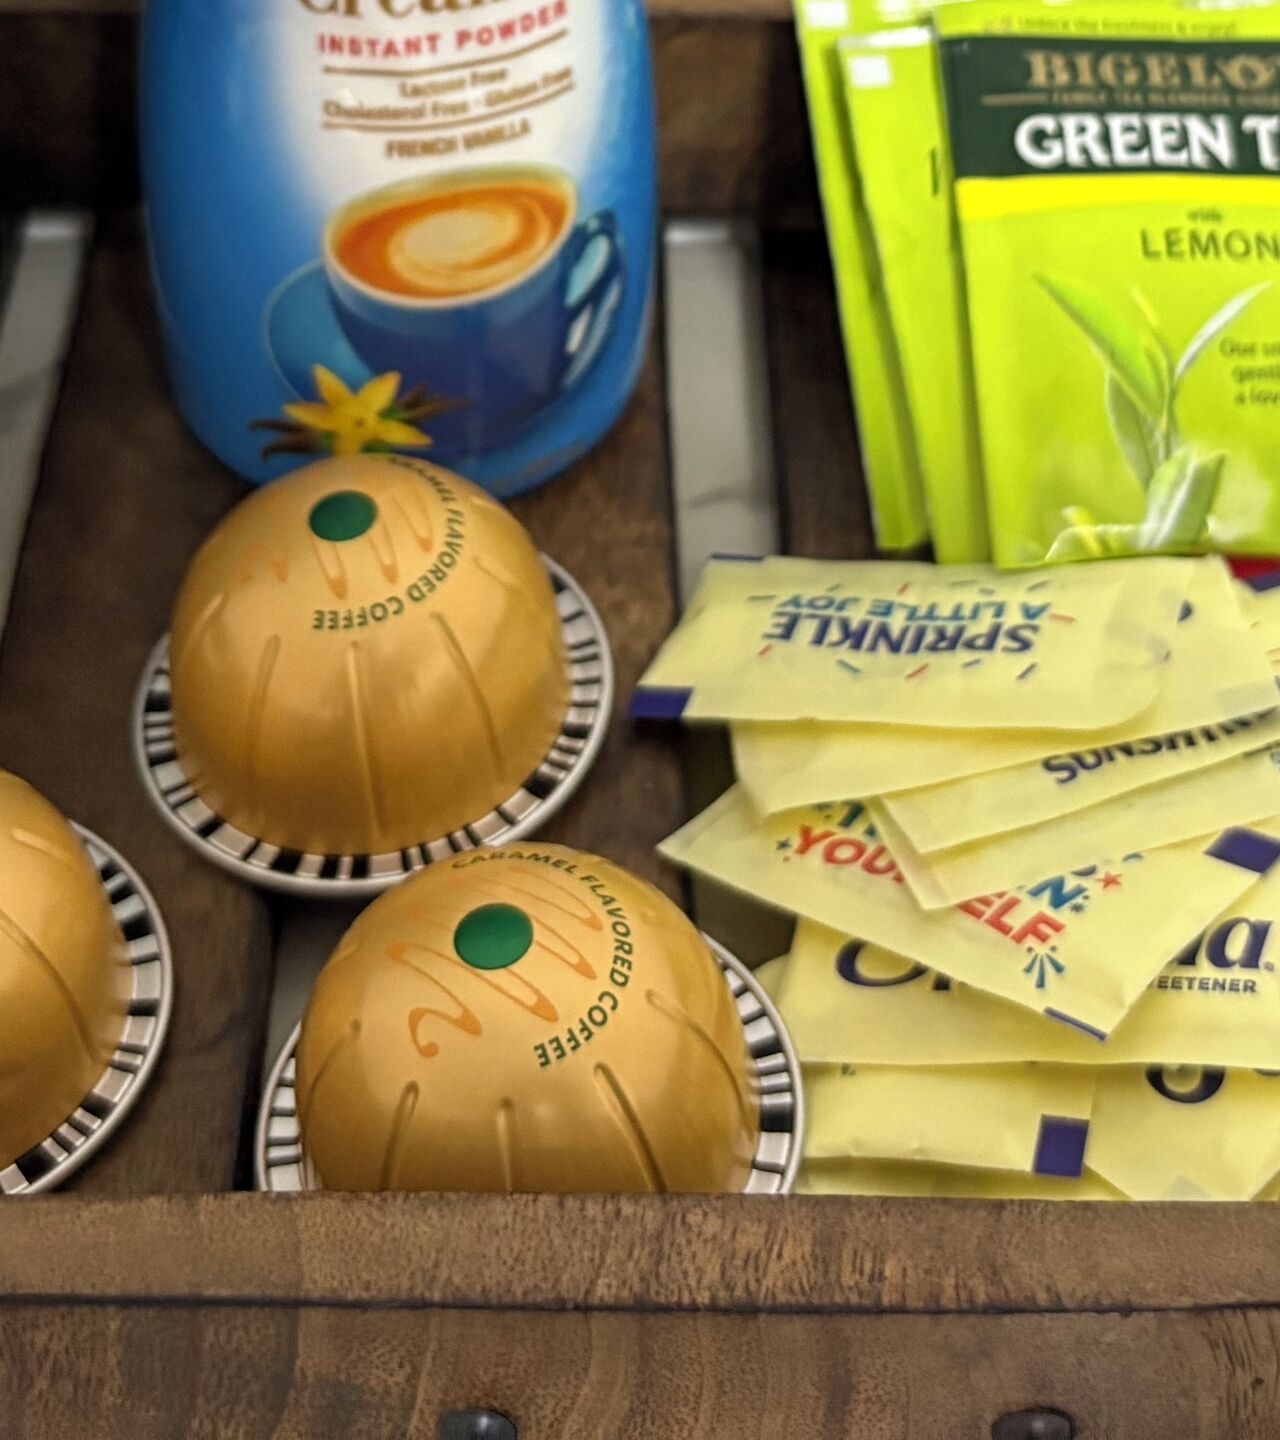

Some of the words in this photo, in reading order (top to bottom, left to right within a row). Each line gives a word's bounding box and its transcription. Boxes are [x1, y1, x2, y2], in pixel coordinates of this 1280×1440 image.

[318, 31, 440, 58] INSTANT
[384, 138, 458, 161] FRENCH
[1013, 111, 1236, 169] GREEN
[405, 508, 465, 603] FLAVORED
[312, 595, 405, 631] COFFEE
[778, 593, 859, 614] JOY
[866, 597, 1006, 623] LITTLE
[1020, 600, 1052, 622] A
[761, 610, 1041, 656] SPRINKLE
[450, 850, 578, 875] CARAMEL
[579, 874, 634, 989] FLAVORED
[1156, 974, 1258, 994] EETENER
[533, 990, 619, 1068] COFFEE
